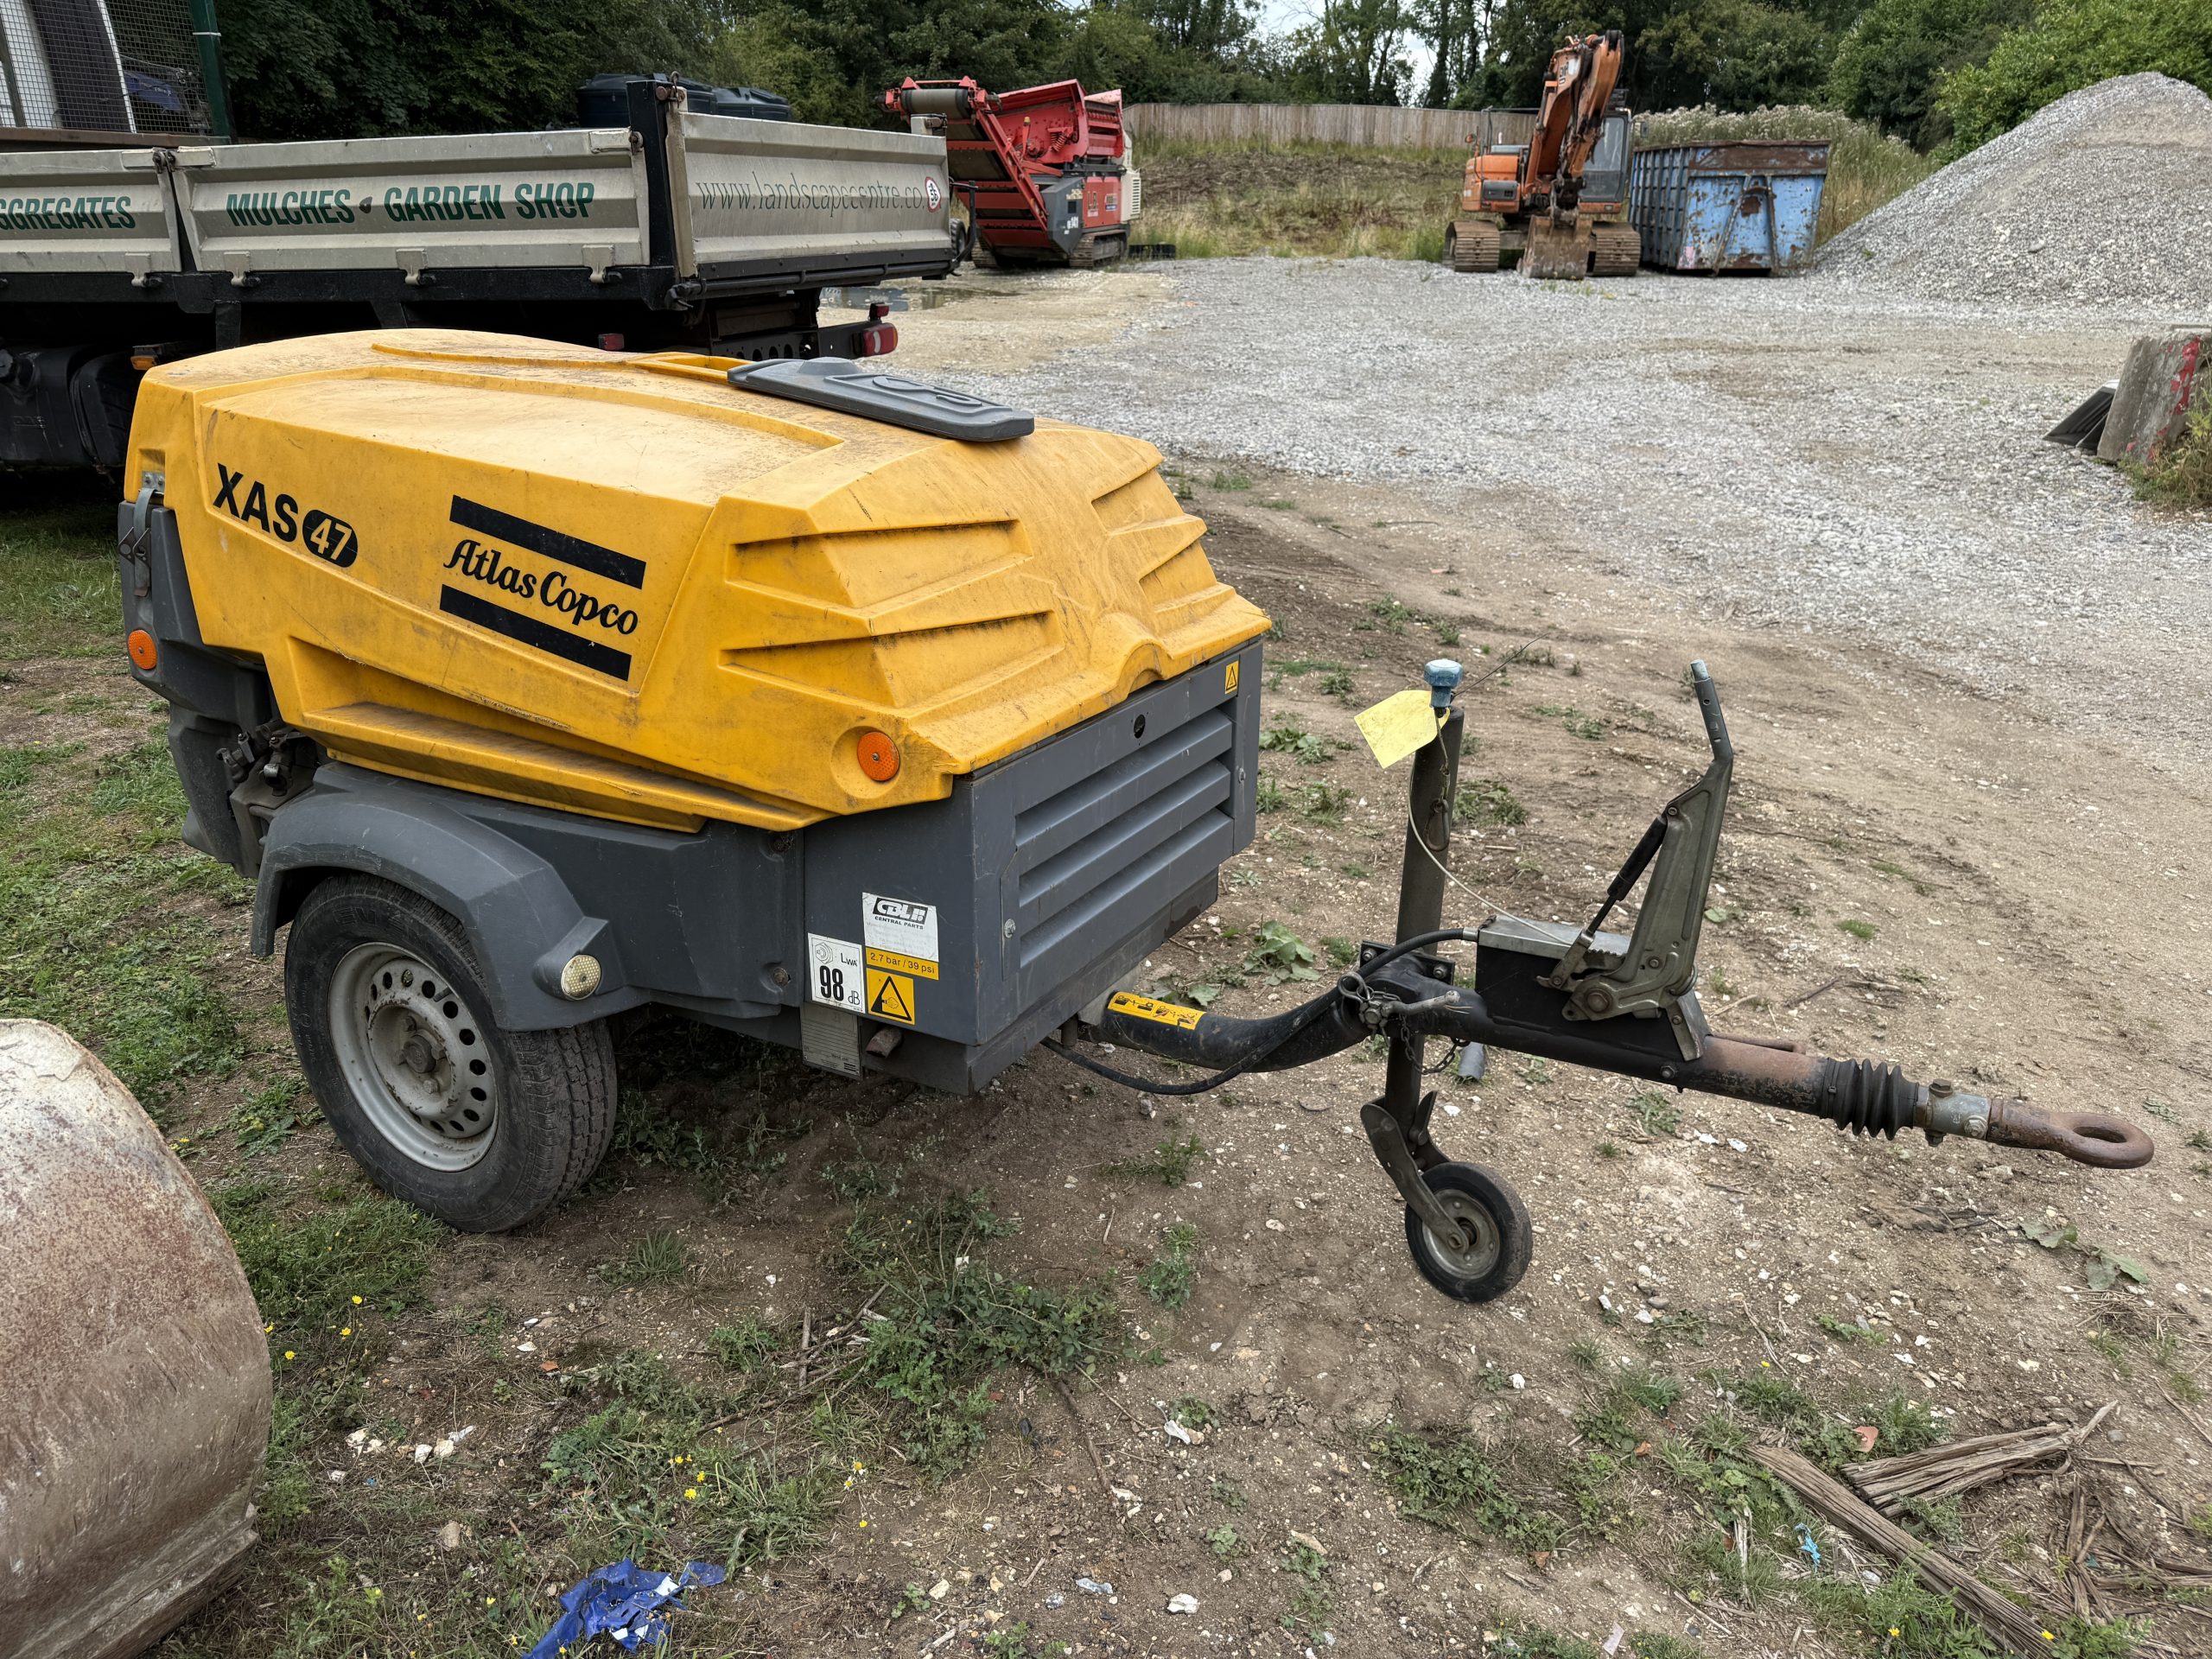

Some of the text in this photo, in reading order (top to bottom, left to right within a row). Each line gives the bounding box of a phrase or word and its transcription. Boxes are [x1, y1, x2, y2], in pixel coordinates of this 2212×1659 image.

[226, 181, 595, 226] MULCHES GARDEN SHOP
[696, 170, 941, 218] www.landscapecentre.co.
[213, 462, 353, 563] XAS 47
[443, 537, 639, 636] Atlas Copco
[874, 915, 924, 931] CENTRAL PARTS
[819, 965, 844, 1001] 98
[870, 952, 884, 962] 2.7
[886, 956, 900, 966] bar
[908, 960, 919, 970] 39
[921, 964, 935, 974] psi
[848, 990, 861, 1006] dB
